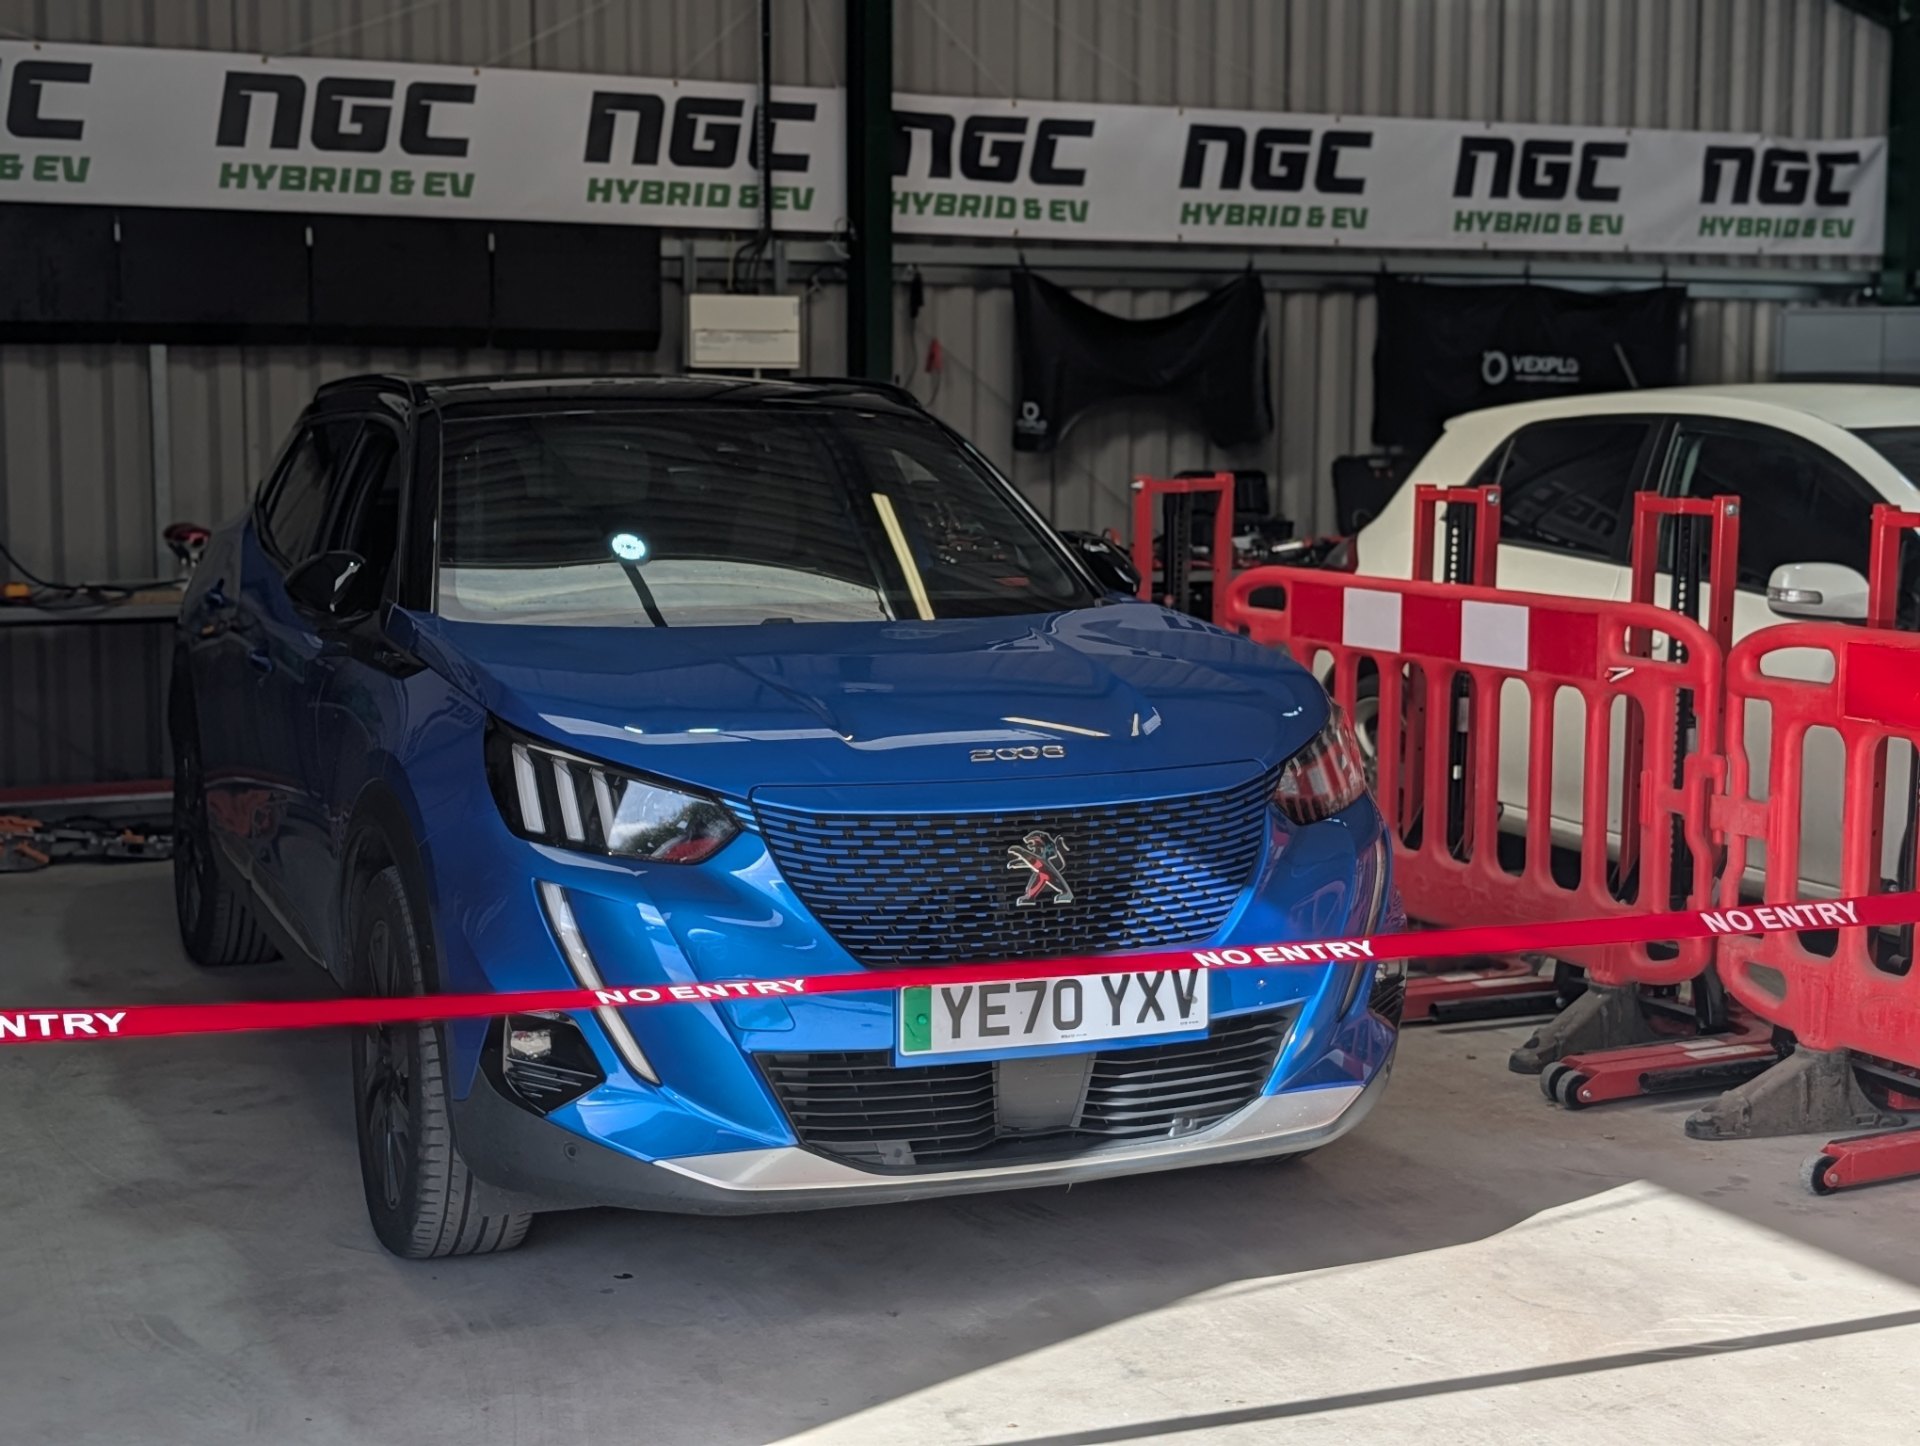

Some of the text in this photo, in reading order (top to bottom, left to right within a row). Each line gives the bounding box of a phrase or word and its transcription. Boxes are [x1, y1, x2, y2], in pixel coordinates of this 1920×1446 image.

[0, 58, 93, 141] C
[215, 70, 477, 158] NGC
[583, 90, 818, 173] NGC
[891, 110, 1096, 187] NGC
[1179, 123, 1374, 195] NGC
[0, 153, 91, 183] & EV
[219, 162, 475, 198] HYBRID & EV
[1452, 135, 1629, 203] NGC
[1699, 145, 1861, 207] NGC
[586, 177, 815, 211] HYBRID & EV
[891, 191, 1089, 223] HYBRID & EV
[1180, 202, 1368, 229] HYBRID & EV
[1453, 210, 1624, 236] HYBRID & EV
[1698, 215, 1856, 239] HYBRID & EV
[969, 745, 1065, 763] 2008
[1700, 900, 1859, 933] NO ENTRY
[1192, 939, 1375, 967] NO ENTRY
[595, 979, 804, 1004] NO ENTRY
[941, 968, 1199, 1040] YE70 YXV
[0, 1011, 126, 1039] NTRY
